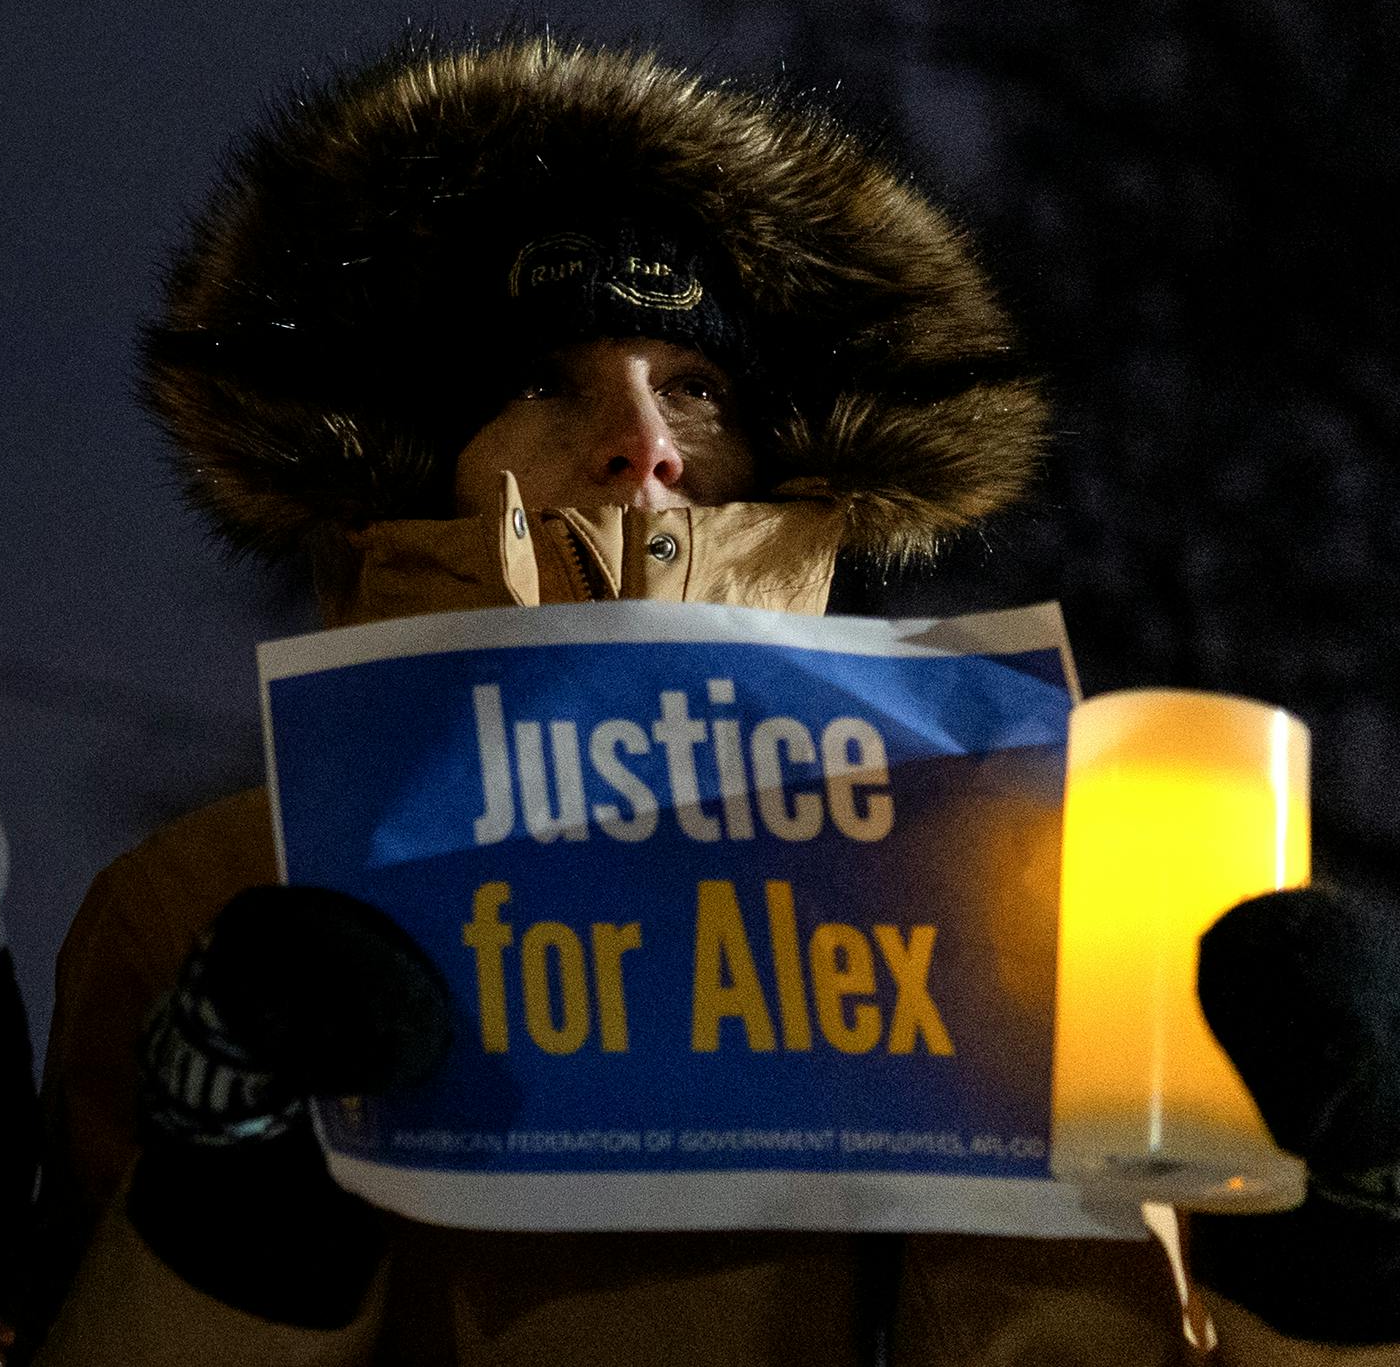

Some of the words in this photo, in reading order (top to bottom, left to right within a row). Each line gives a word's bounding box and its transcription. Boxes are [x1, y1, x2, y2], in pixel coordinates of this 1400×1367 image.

[472, 678, 896, 846] Justice
[461, 881, 643, 1056] for
[690, 879, 955, 1057] Alex
[506, 1131, 640, 1152] FEDERATION
[644, 1131, 673, 1152] OF
[678, 1131, 836, 1152] GOVERNMENT
